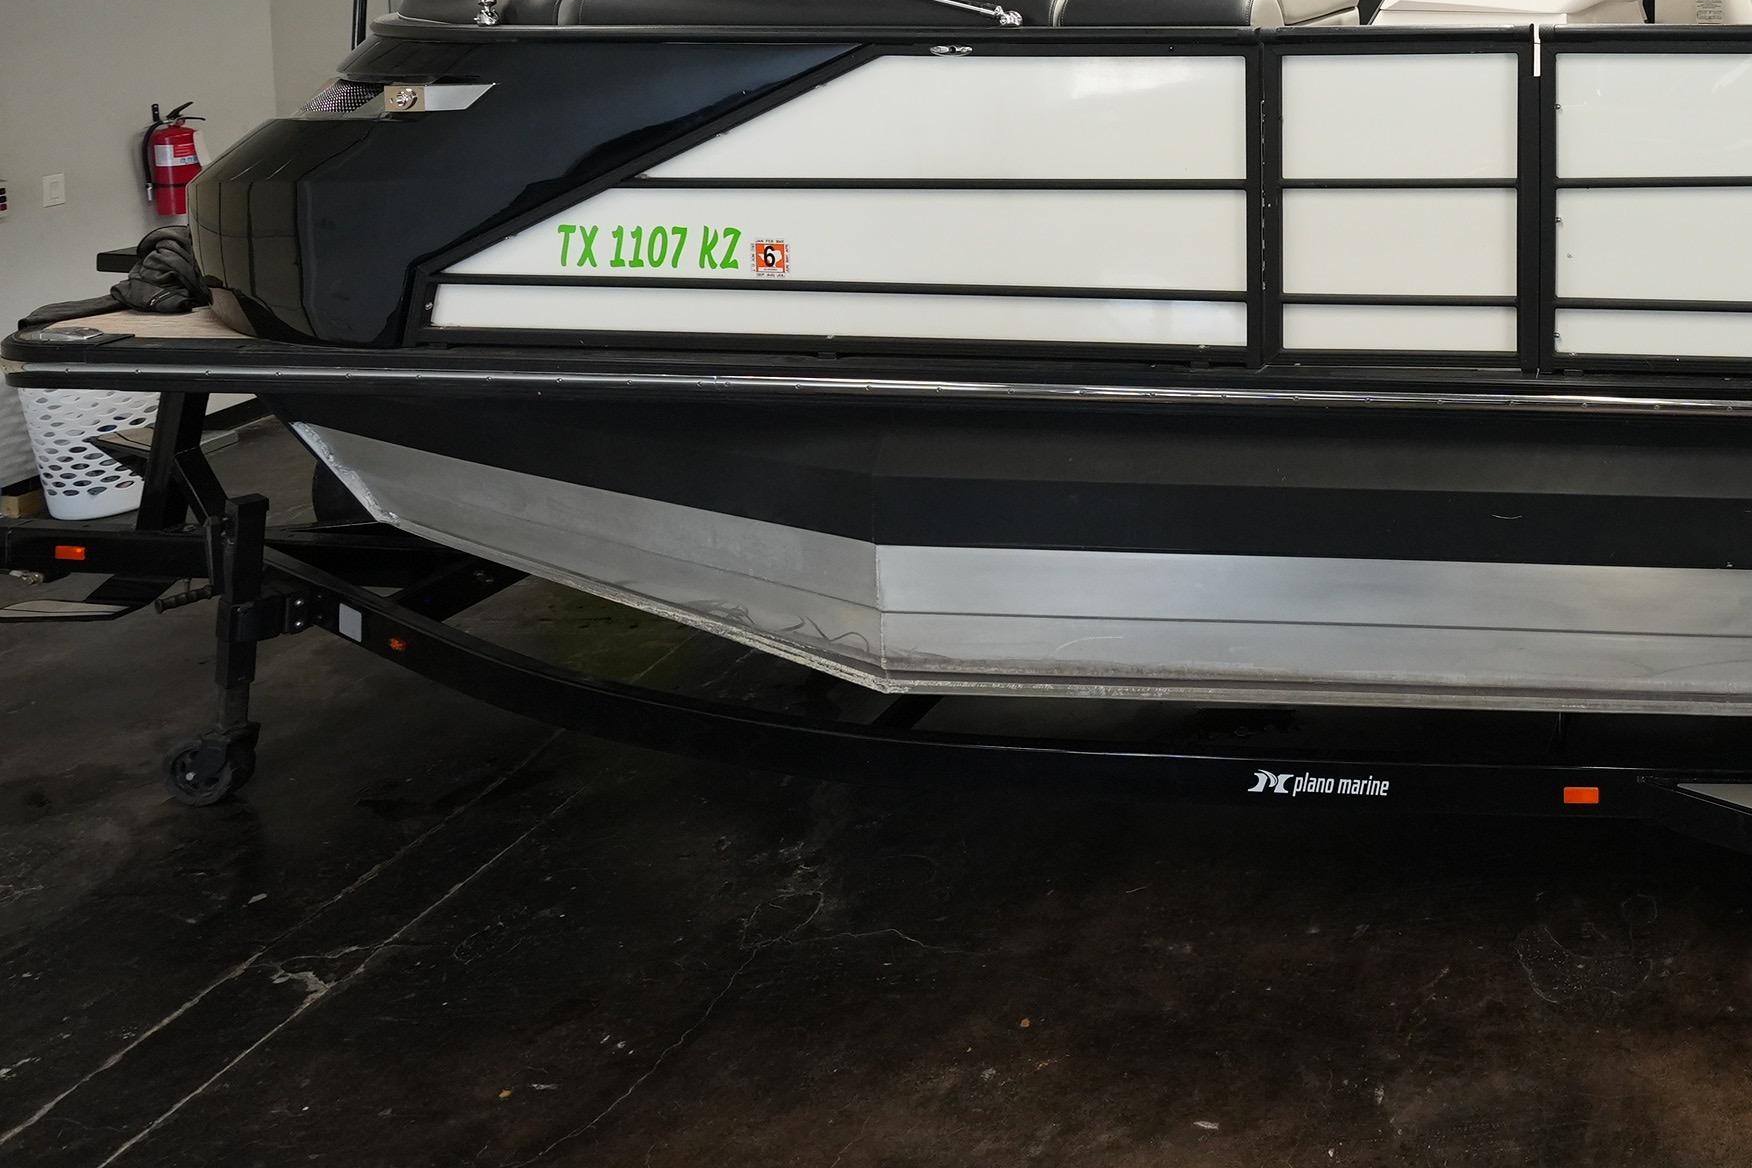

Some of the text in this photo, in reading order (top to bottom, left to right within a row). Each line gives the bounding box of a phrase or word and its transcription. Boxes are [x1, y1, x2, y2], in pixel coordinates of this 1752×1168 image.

[557, 224, 600, 268] TX
[609, 224, 689, 269] 1107
[699, 224, 743, 270] KZ
[763, 245, 776, 268] 6
[1292, 771, 1390, 797] plano marine
